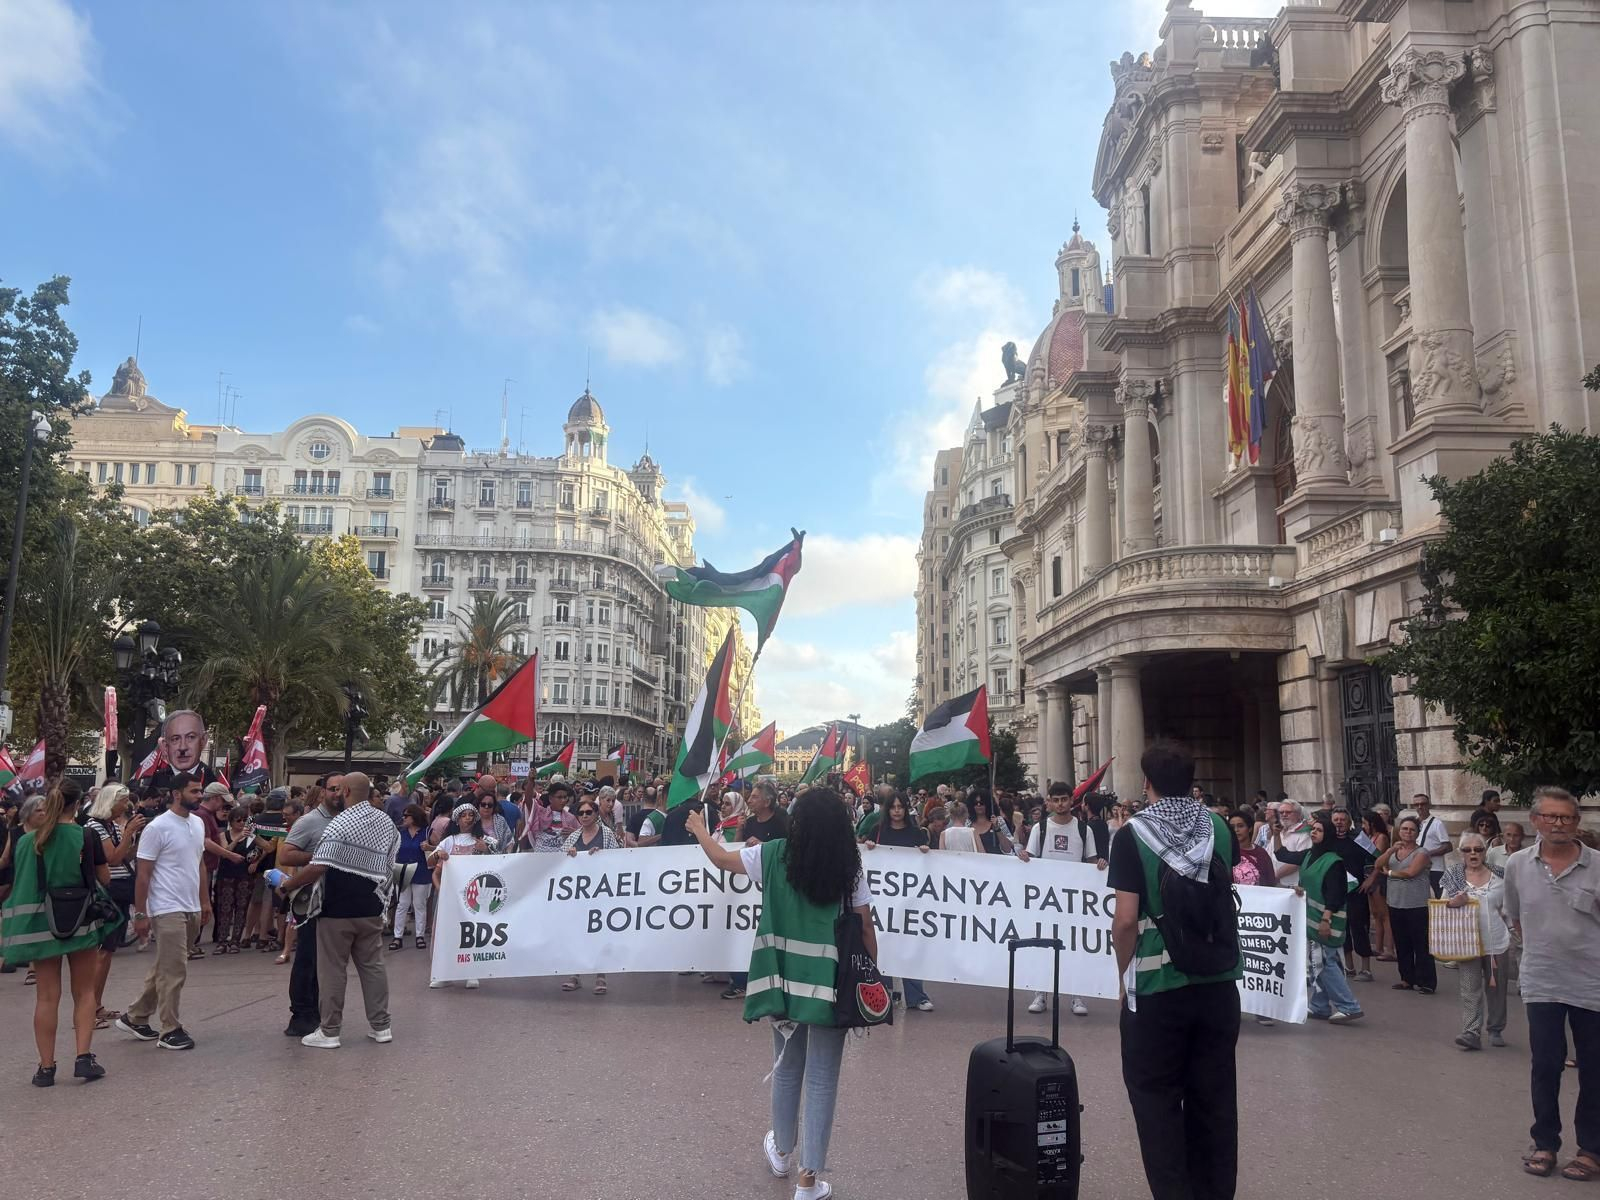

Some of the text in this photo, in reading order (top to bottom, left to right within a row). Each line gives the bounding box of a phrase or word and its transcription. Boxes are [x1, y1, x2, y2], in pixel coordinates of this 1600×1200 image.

[547, 867, 762, 901] ISRAEL GENO
[867, 869, 1012, 908] ESPANYA
[587, 904, 714, 934] BOICOT
[459, 921, 509, 949] BDS
[1242, 975, 1285, 998] ISRAEL
